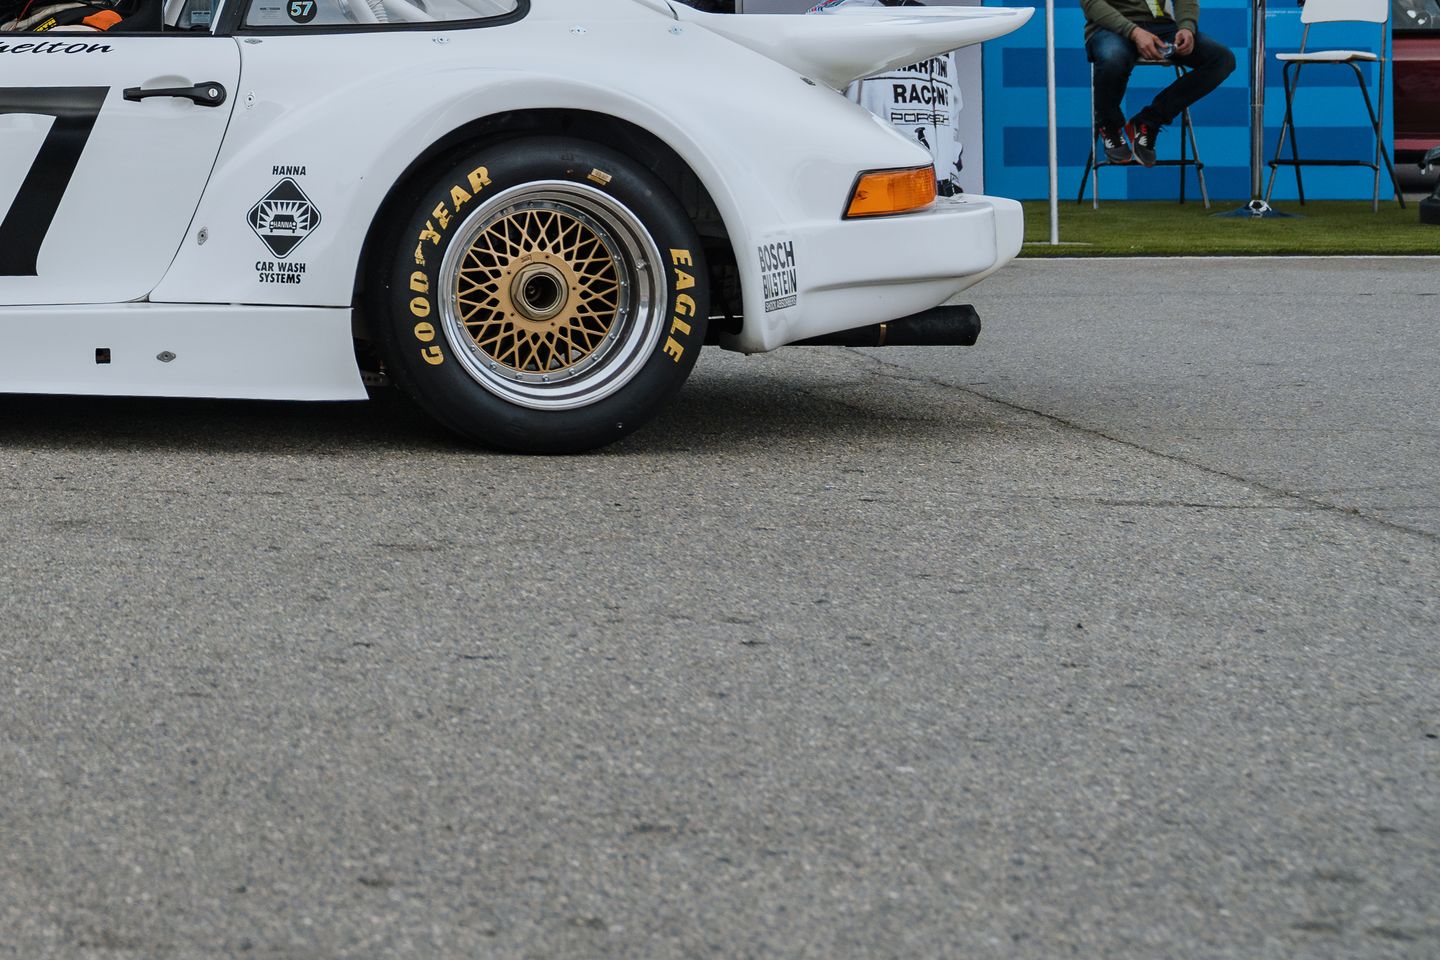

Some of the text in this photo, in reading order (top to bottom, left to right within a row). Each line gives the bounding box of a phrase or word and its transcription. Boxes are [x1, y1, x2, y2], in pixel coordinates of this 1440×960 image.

[290, 1, 313, 16] 57
[272, 165, 306, 176] HANNA
[758, 240, 795, 273] BOSCH
[255, 261, 306, 273] CAR WASH
[259, 272, 301, 284] SYSTEMS
[762, 268, 797, 299] BILSTEIN
[663, 247, 697, 363] EAGLE
